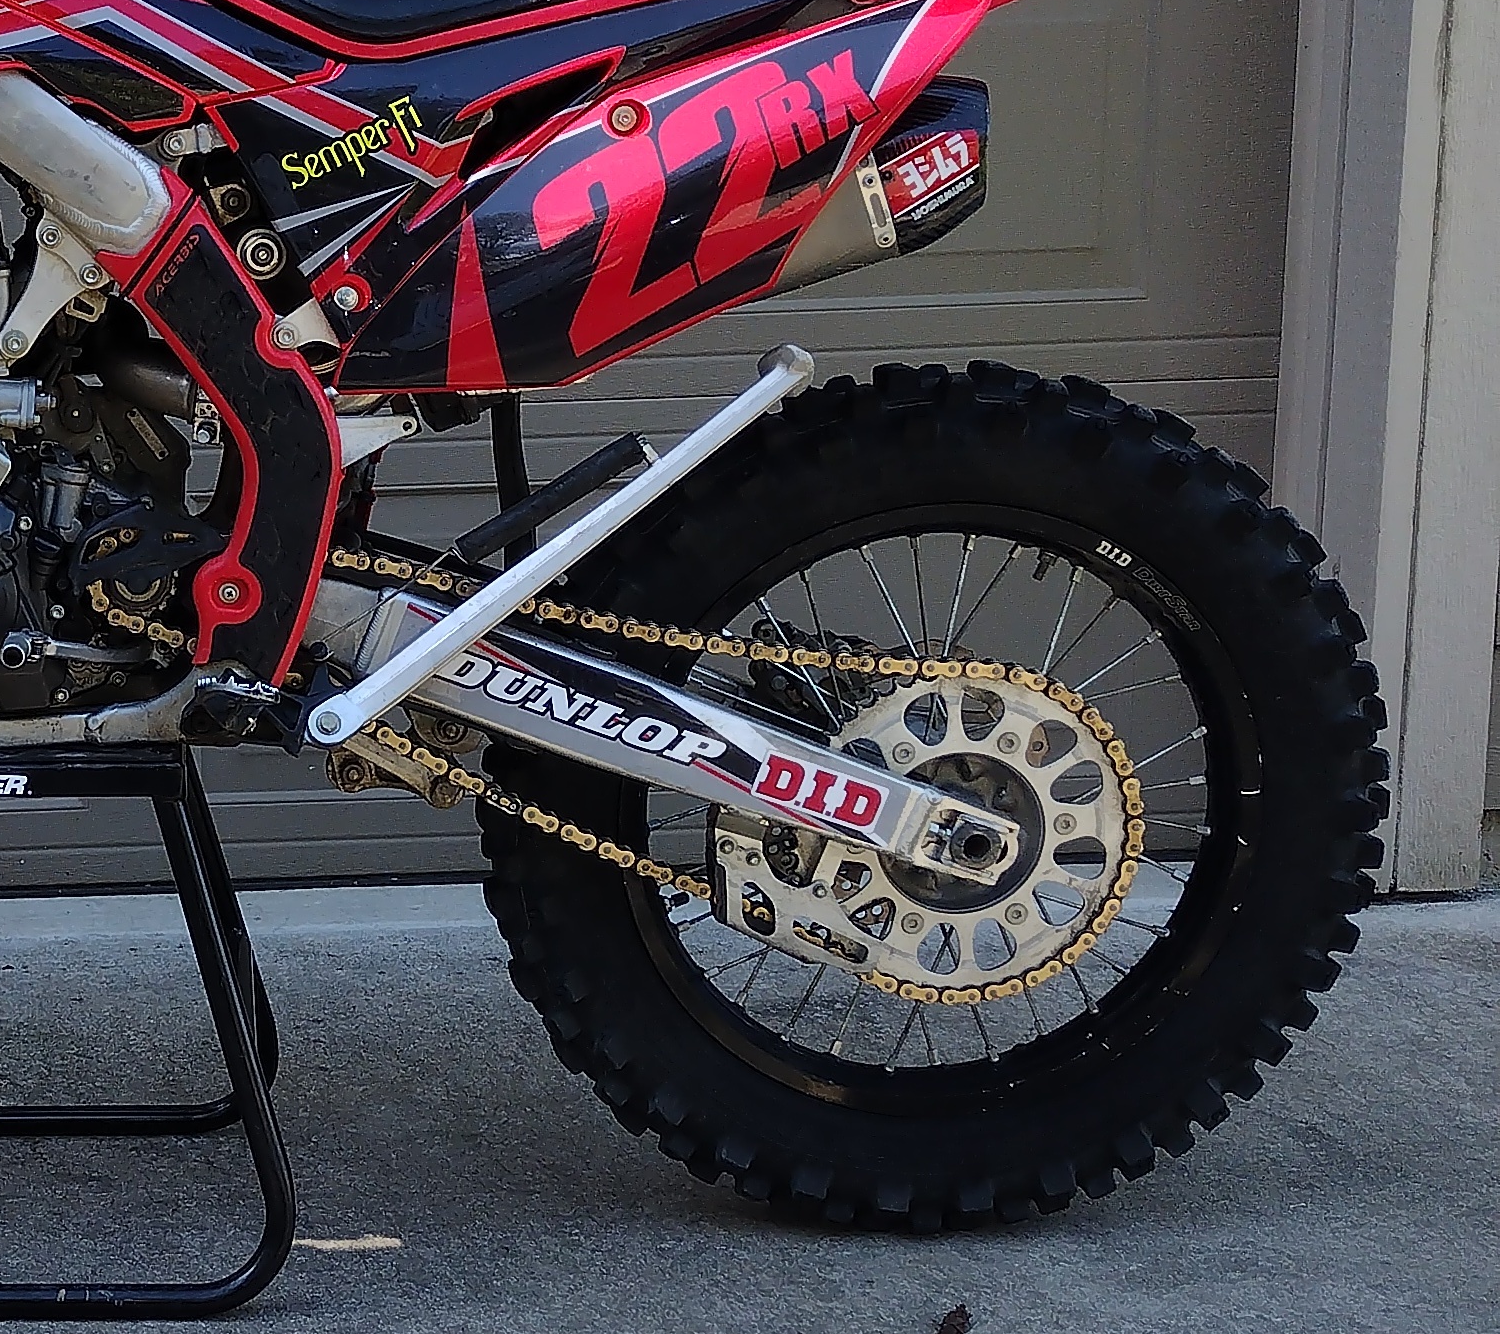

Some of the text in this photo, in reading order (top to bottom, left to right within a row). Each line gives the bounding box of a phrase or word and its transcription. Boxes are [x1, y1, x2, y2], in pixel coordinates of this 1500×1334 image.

[281, 96, 422, 189] Semper Fi
[896, 133, 969, 199] ヨシムラ
[432, 651, 729, 766] DUNLOP
